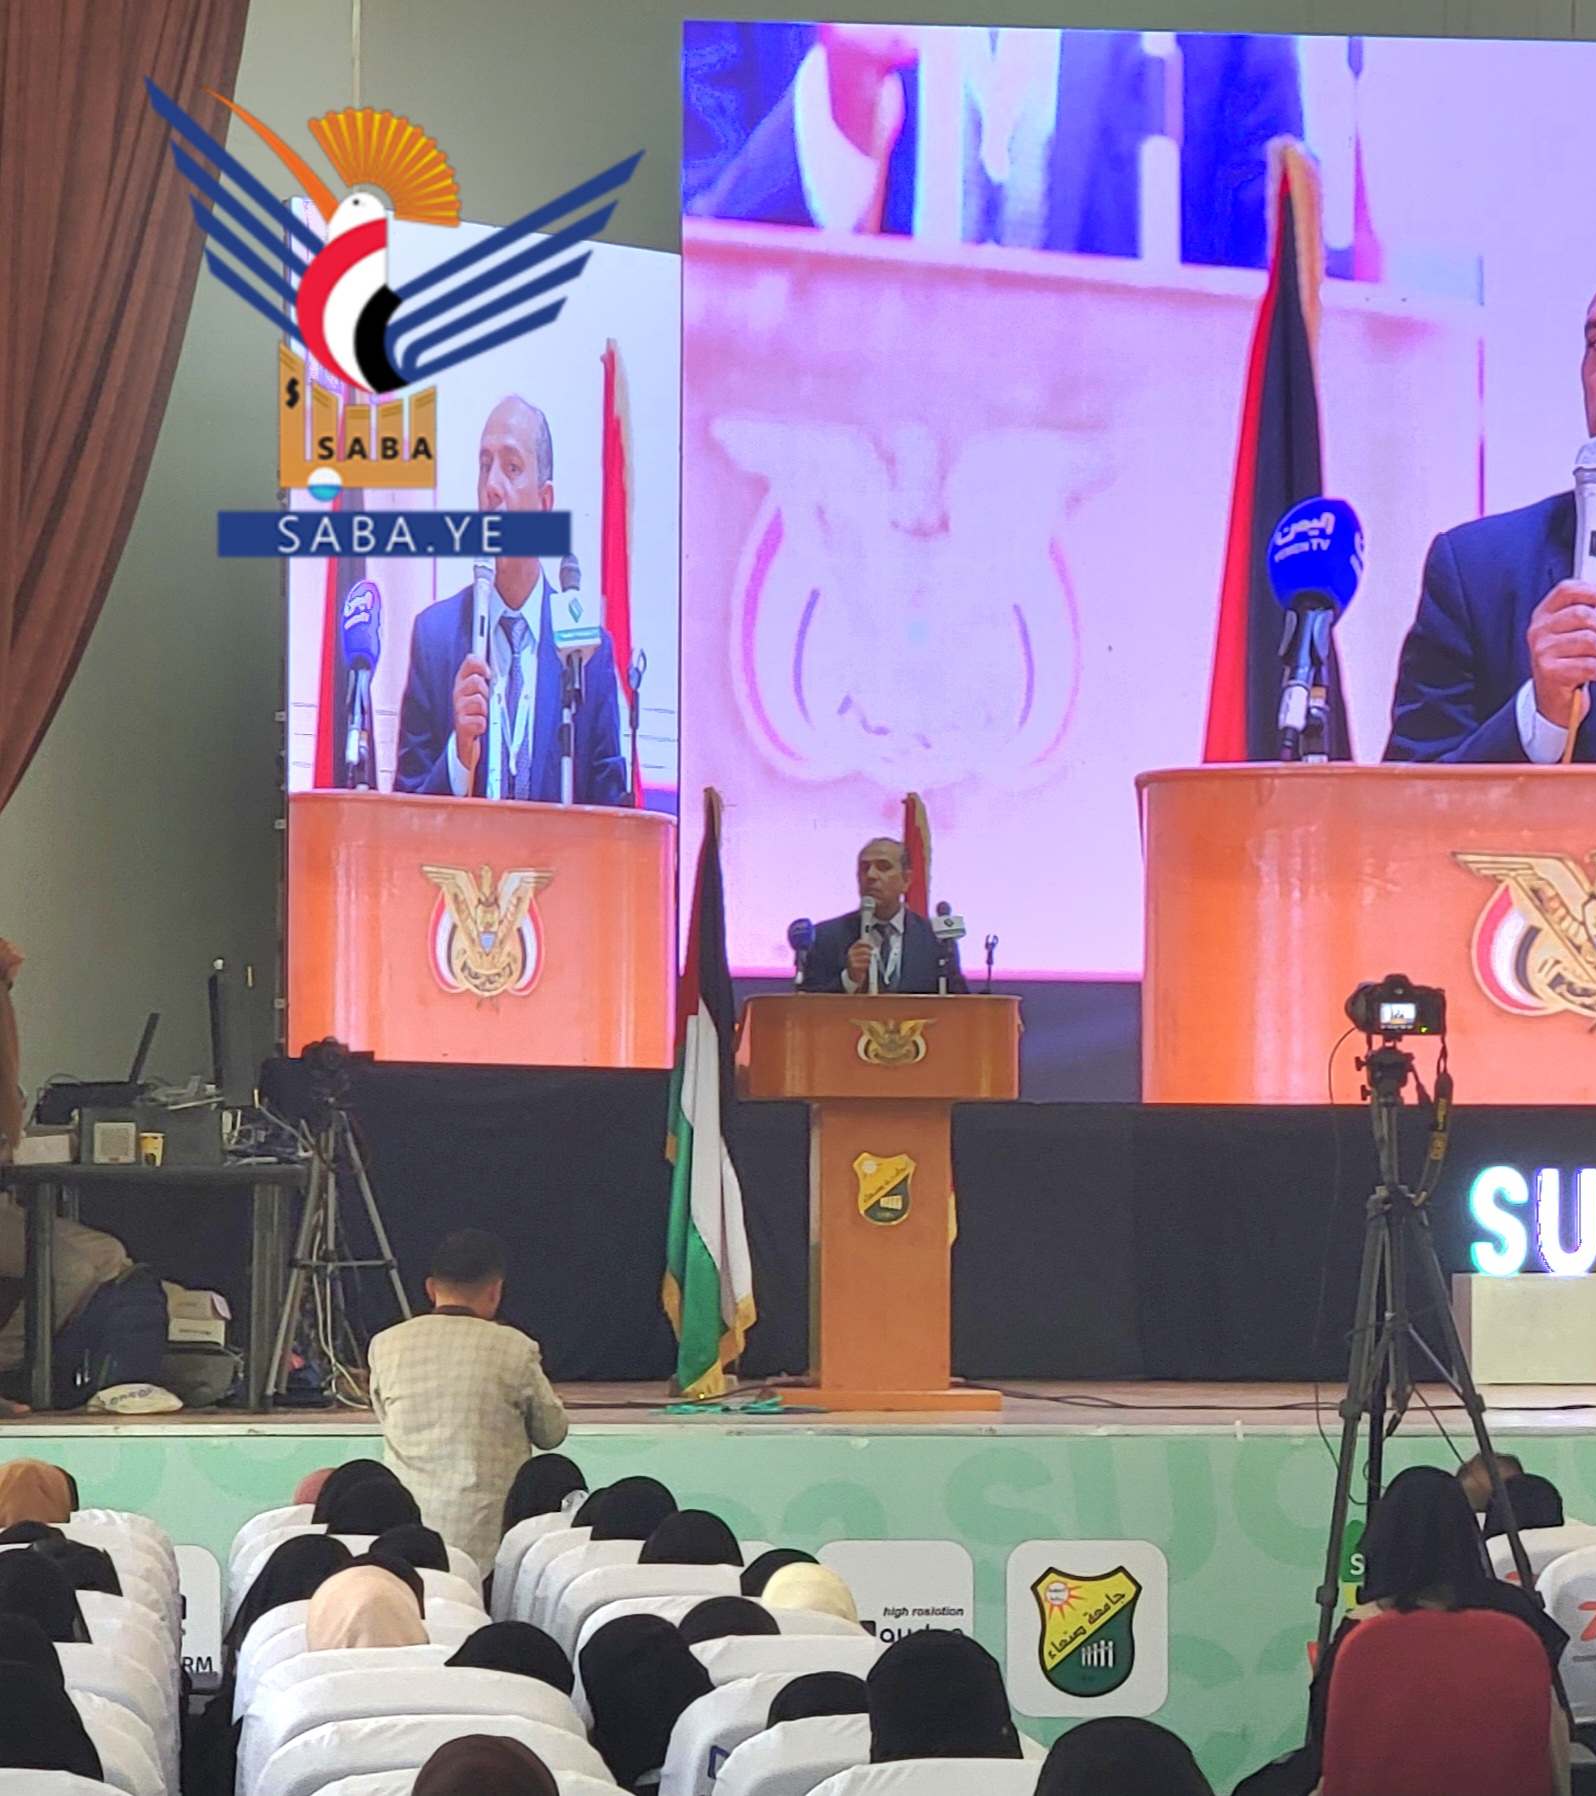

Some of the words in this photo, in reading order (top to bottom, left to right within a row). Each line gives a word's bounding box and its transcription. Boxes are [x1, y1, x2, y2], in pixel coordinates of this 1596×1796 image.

[1309, 537, 1332, 551] TV
[883, 1606, 909, 1619] high
[1083, 1592, 1126, 1625] جامعة
[1048, 1625, 1087, 1660] صنعاء
